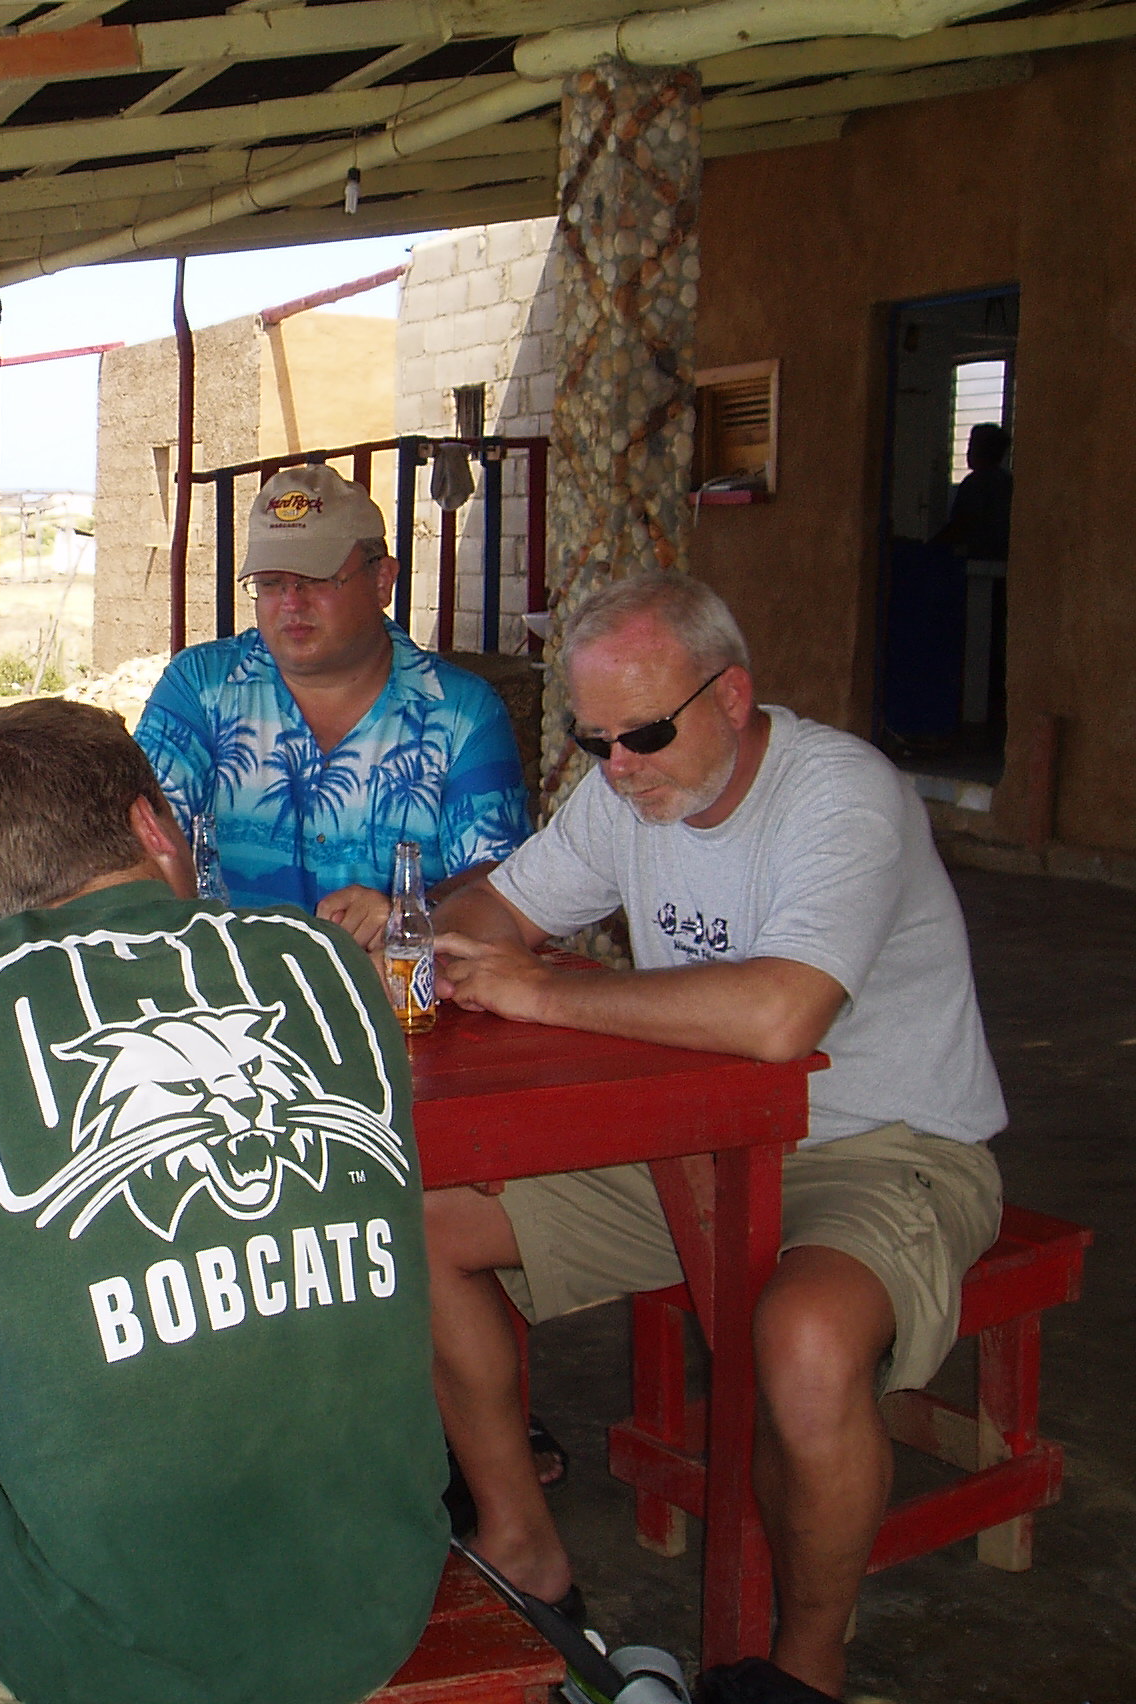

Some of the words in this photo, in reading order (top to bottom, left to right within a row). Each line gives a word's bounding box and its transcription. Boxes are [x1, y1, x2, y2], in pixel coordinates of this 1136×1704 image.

[265, 495, 295, 514] Hard
[292, 495, 323, 513] Rock
[88, 1217, 396, 1363] BOBCATS
